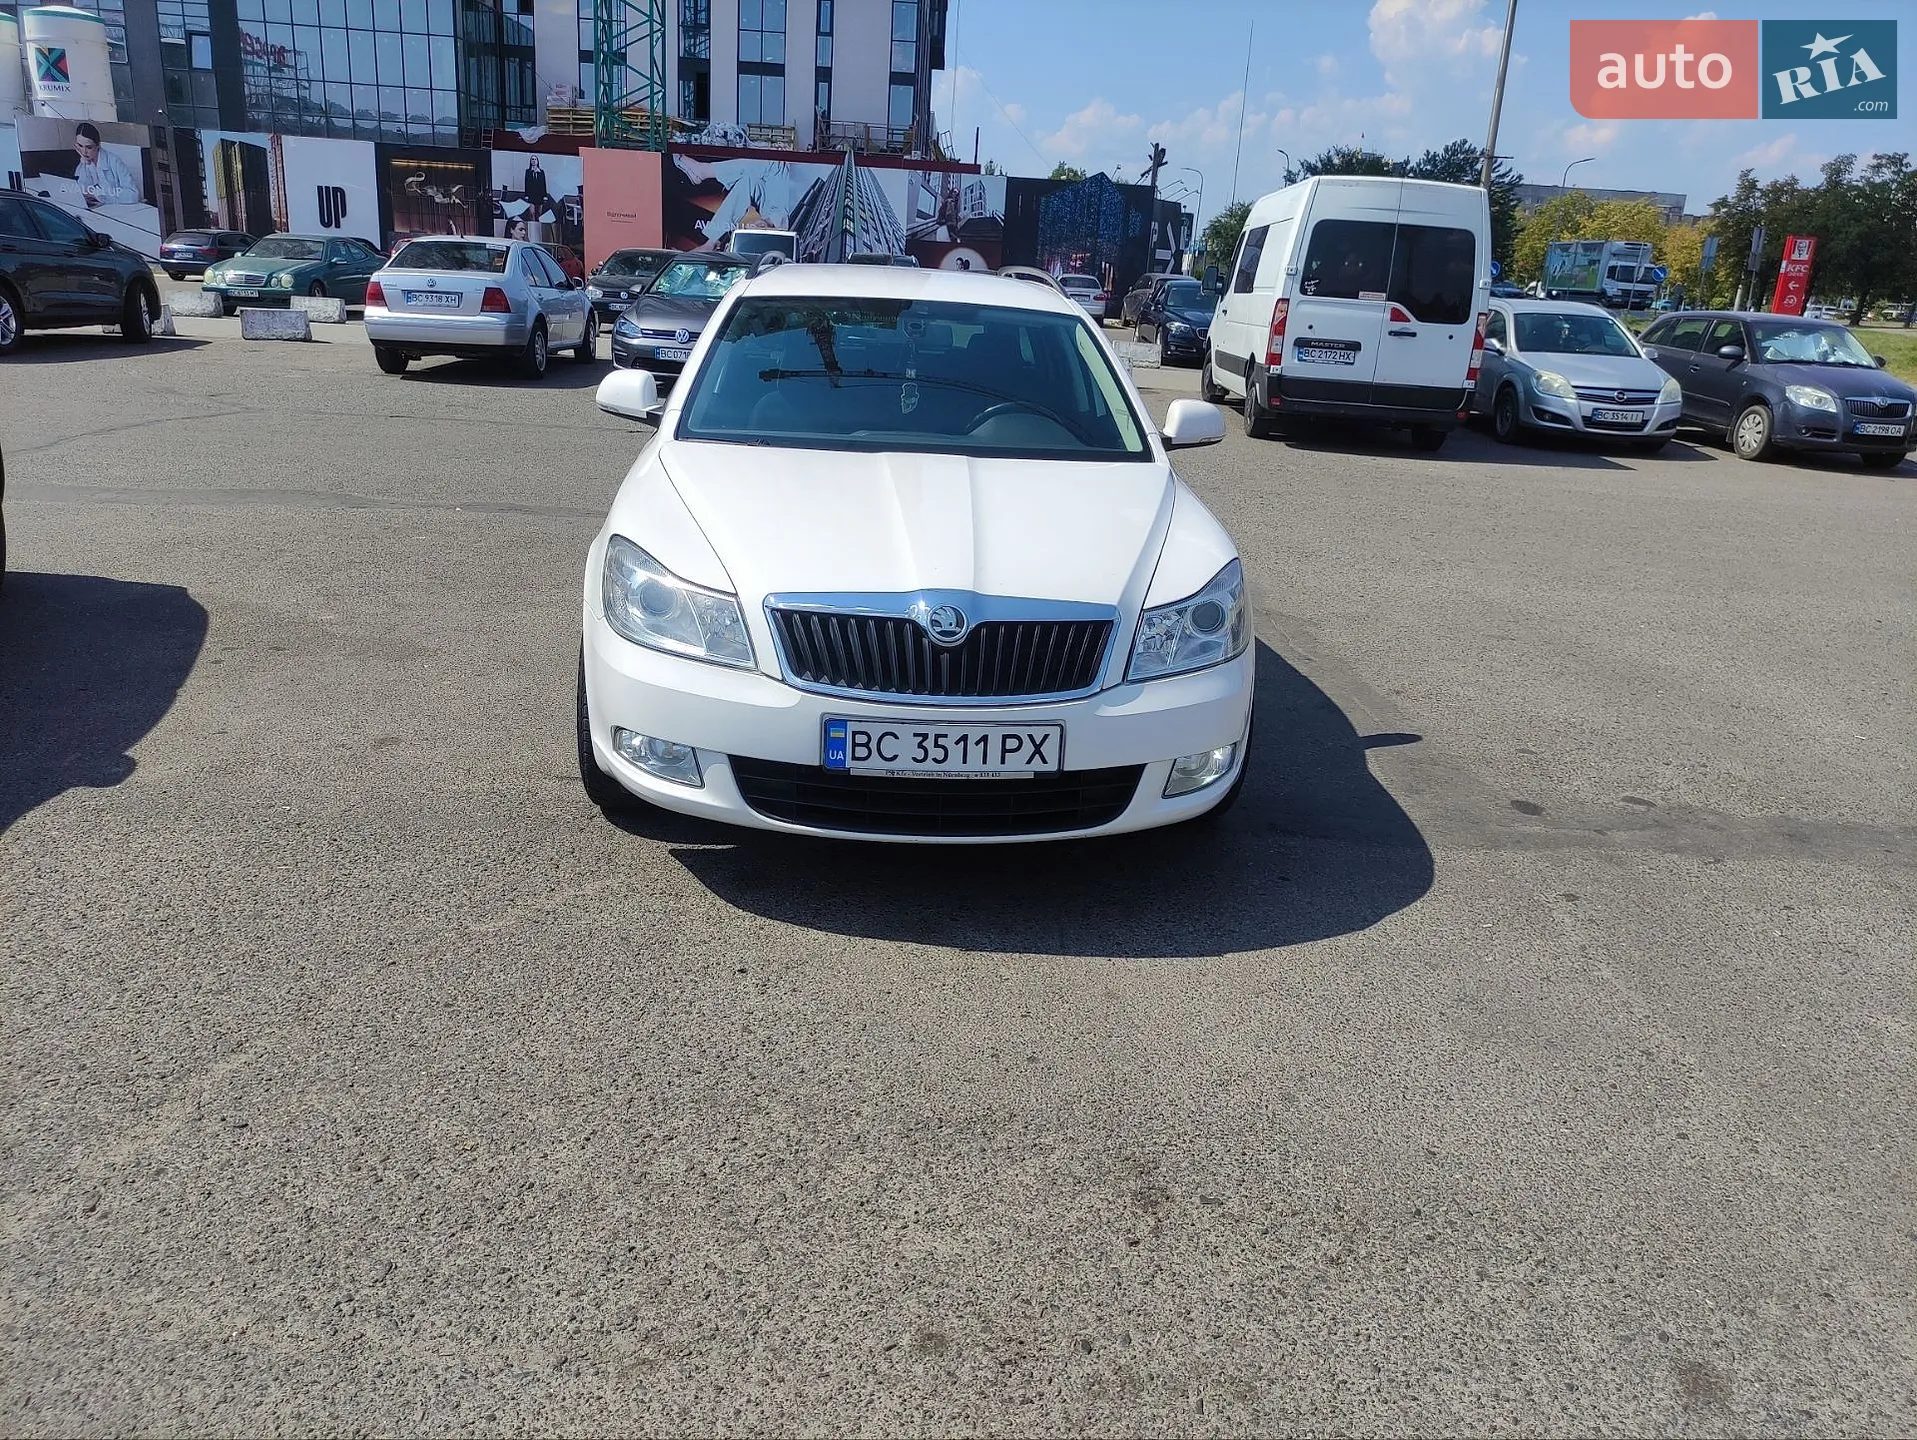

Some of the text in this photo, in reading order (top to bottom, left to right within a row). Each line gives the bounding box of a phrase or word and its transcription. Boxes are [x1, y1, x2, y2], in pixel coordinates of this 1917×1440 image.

[316, 185, 347, 229] UP
[1787, 264, 1809, 273] KFC
[412, 293, 457, 304] BC 9318 XH
[1310, 341, 1346, 349] MASTER
[660, 349, 672, 358] BC
[1303, 348, 1352, 361] BC 2172 HX
[851, 730, 1051, 765] BC 3511 PX
[829, 751, 845, 761] UA
